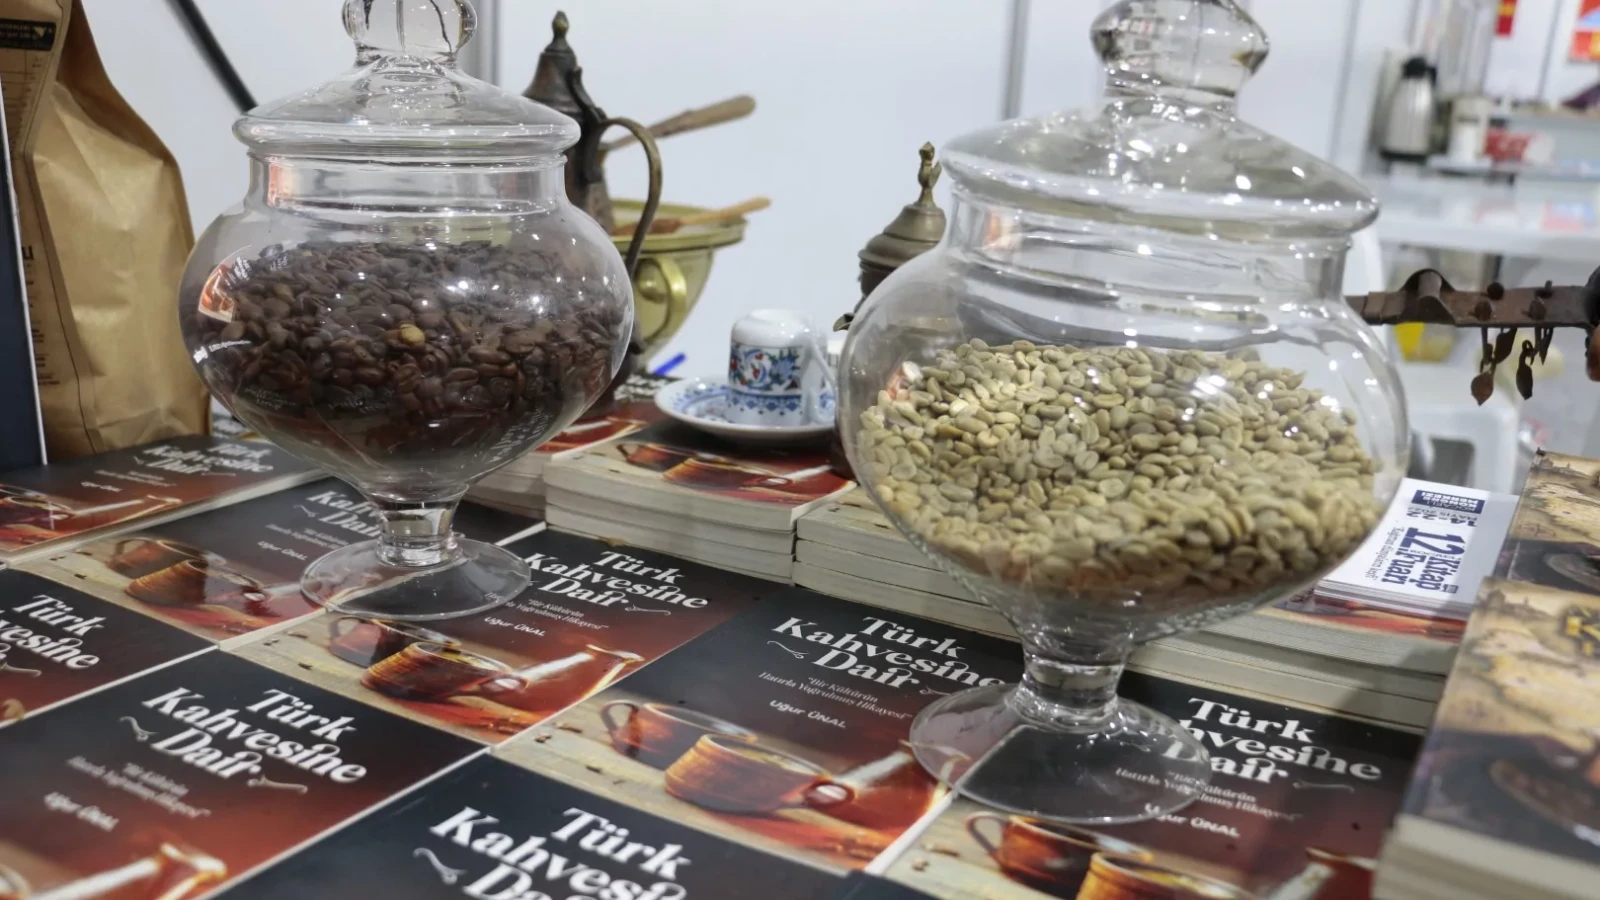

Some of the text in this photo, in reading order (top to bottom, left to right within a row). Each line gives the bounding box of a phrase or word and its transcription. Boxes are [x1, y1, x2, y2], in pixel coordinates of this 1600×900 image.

[524, 553, 708, 608] Kahvesine
[593, 550, 686, 585] Türk
[1381, 551, 1427, 584] Fuarı
[1409, 556, 1460, 591] Kitap
[538, 577, 628, 607] Dair
[12, 594, 107, 637] Türk
[484, 616, 546, 636] Uğur ÜNAL
[0, 610, 100, 669] vesine
[859, 616, 966, 658] Türk
[758, 672, 797, 688] Hatırla
[812, 648, 920, 689] Dair
[142, 687, 368, 783] Kahvesine
[245, 688, 356, 742] Türk
[769, 699, 847, 729] Uğur ÜNAL
[1187, 697, 1316, 743] Türk
[151, 727, 263, 779] Dair
[1177, 718, 1383, 781] hvesine
[551, 807, 692, 880] Türk
[1191, 816, 1241, 839] ÜNAL
[429, 806, 687, 900] Kahves
